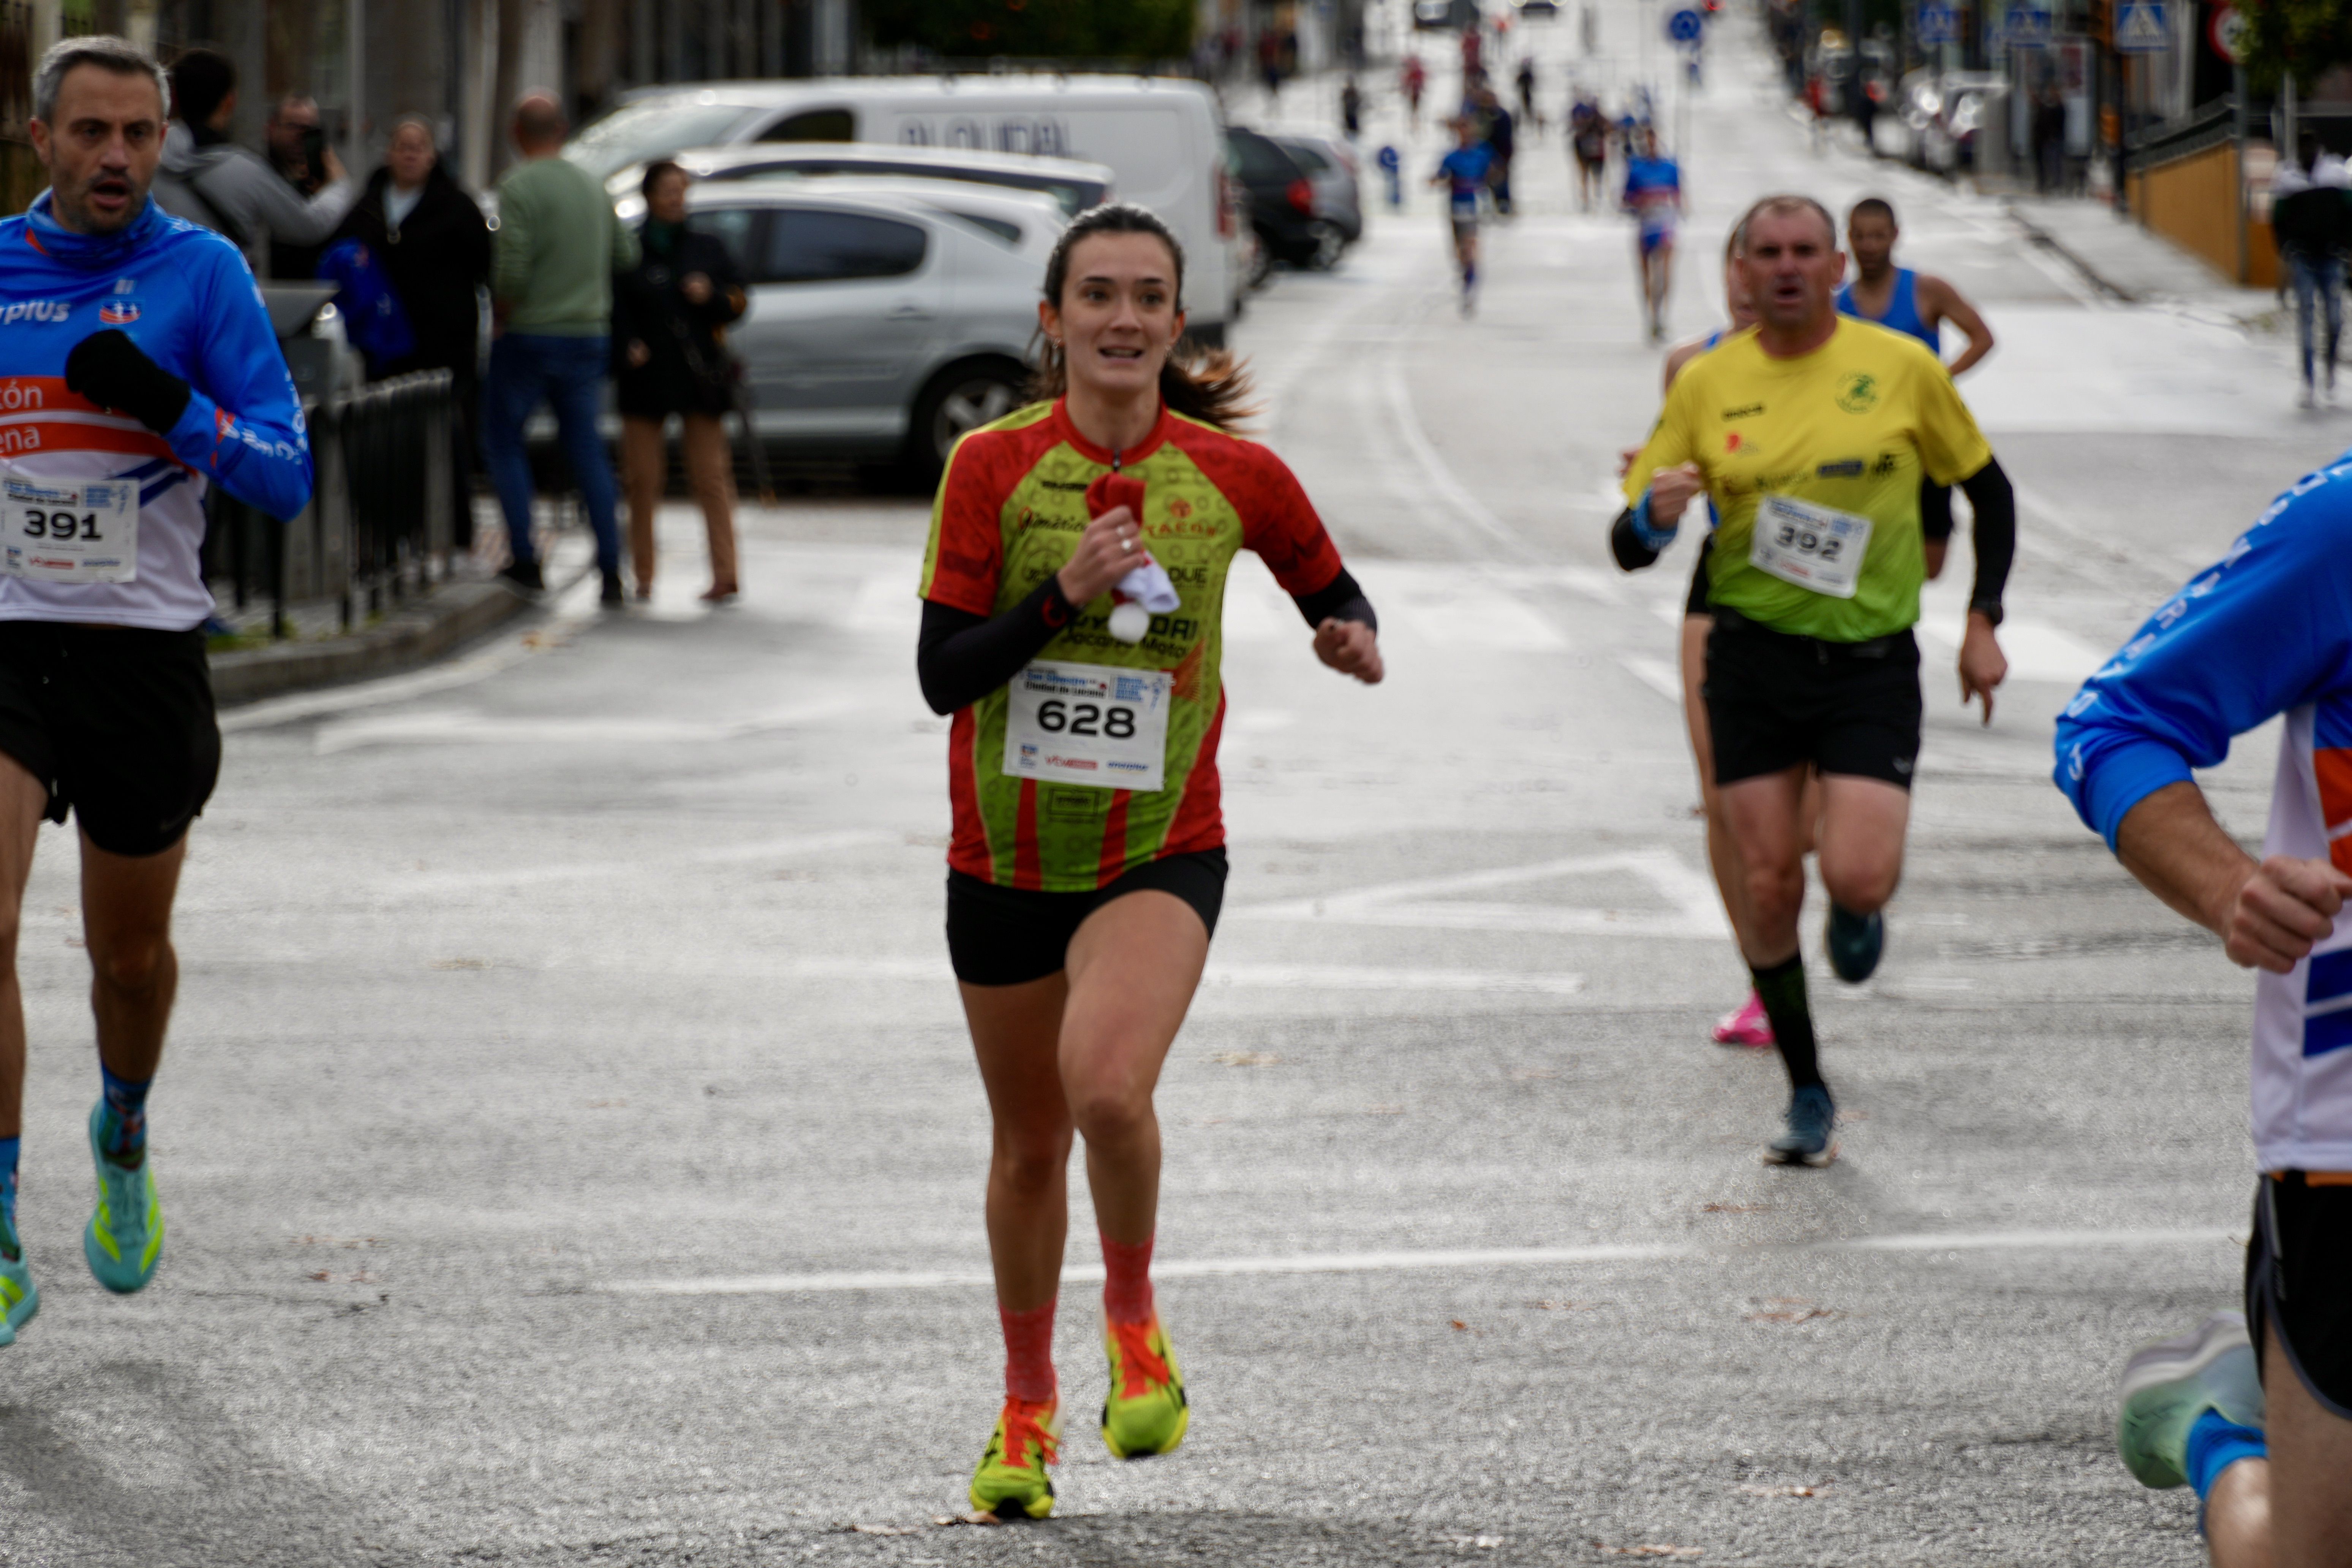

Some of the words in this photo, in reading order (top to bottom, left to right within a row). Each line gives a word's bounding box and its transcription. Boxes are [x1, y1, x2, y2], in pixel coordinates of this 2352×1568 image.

[23, 509, 103, 541] 391
[1775, 525, 1841, 563] 392
[1038, 700, 1135, 738] 628
